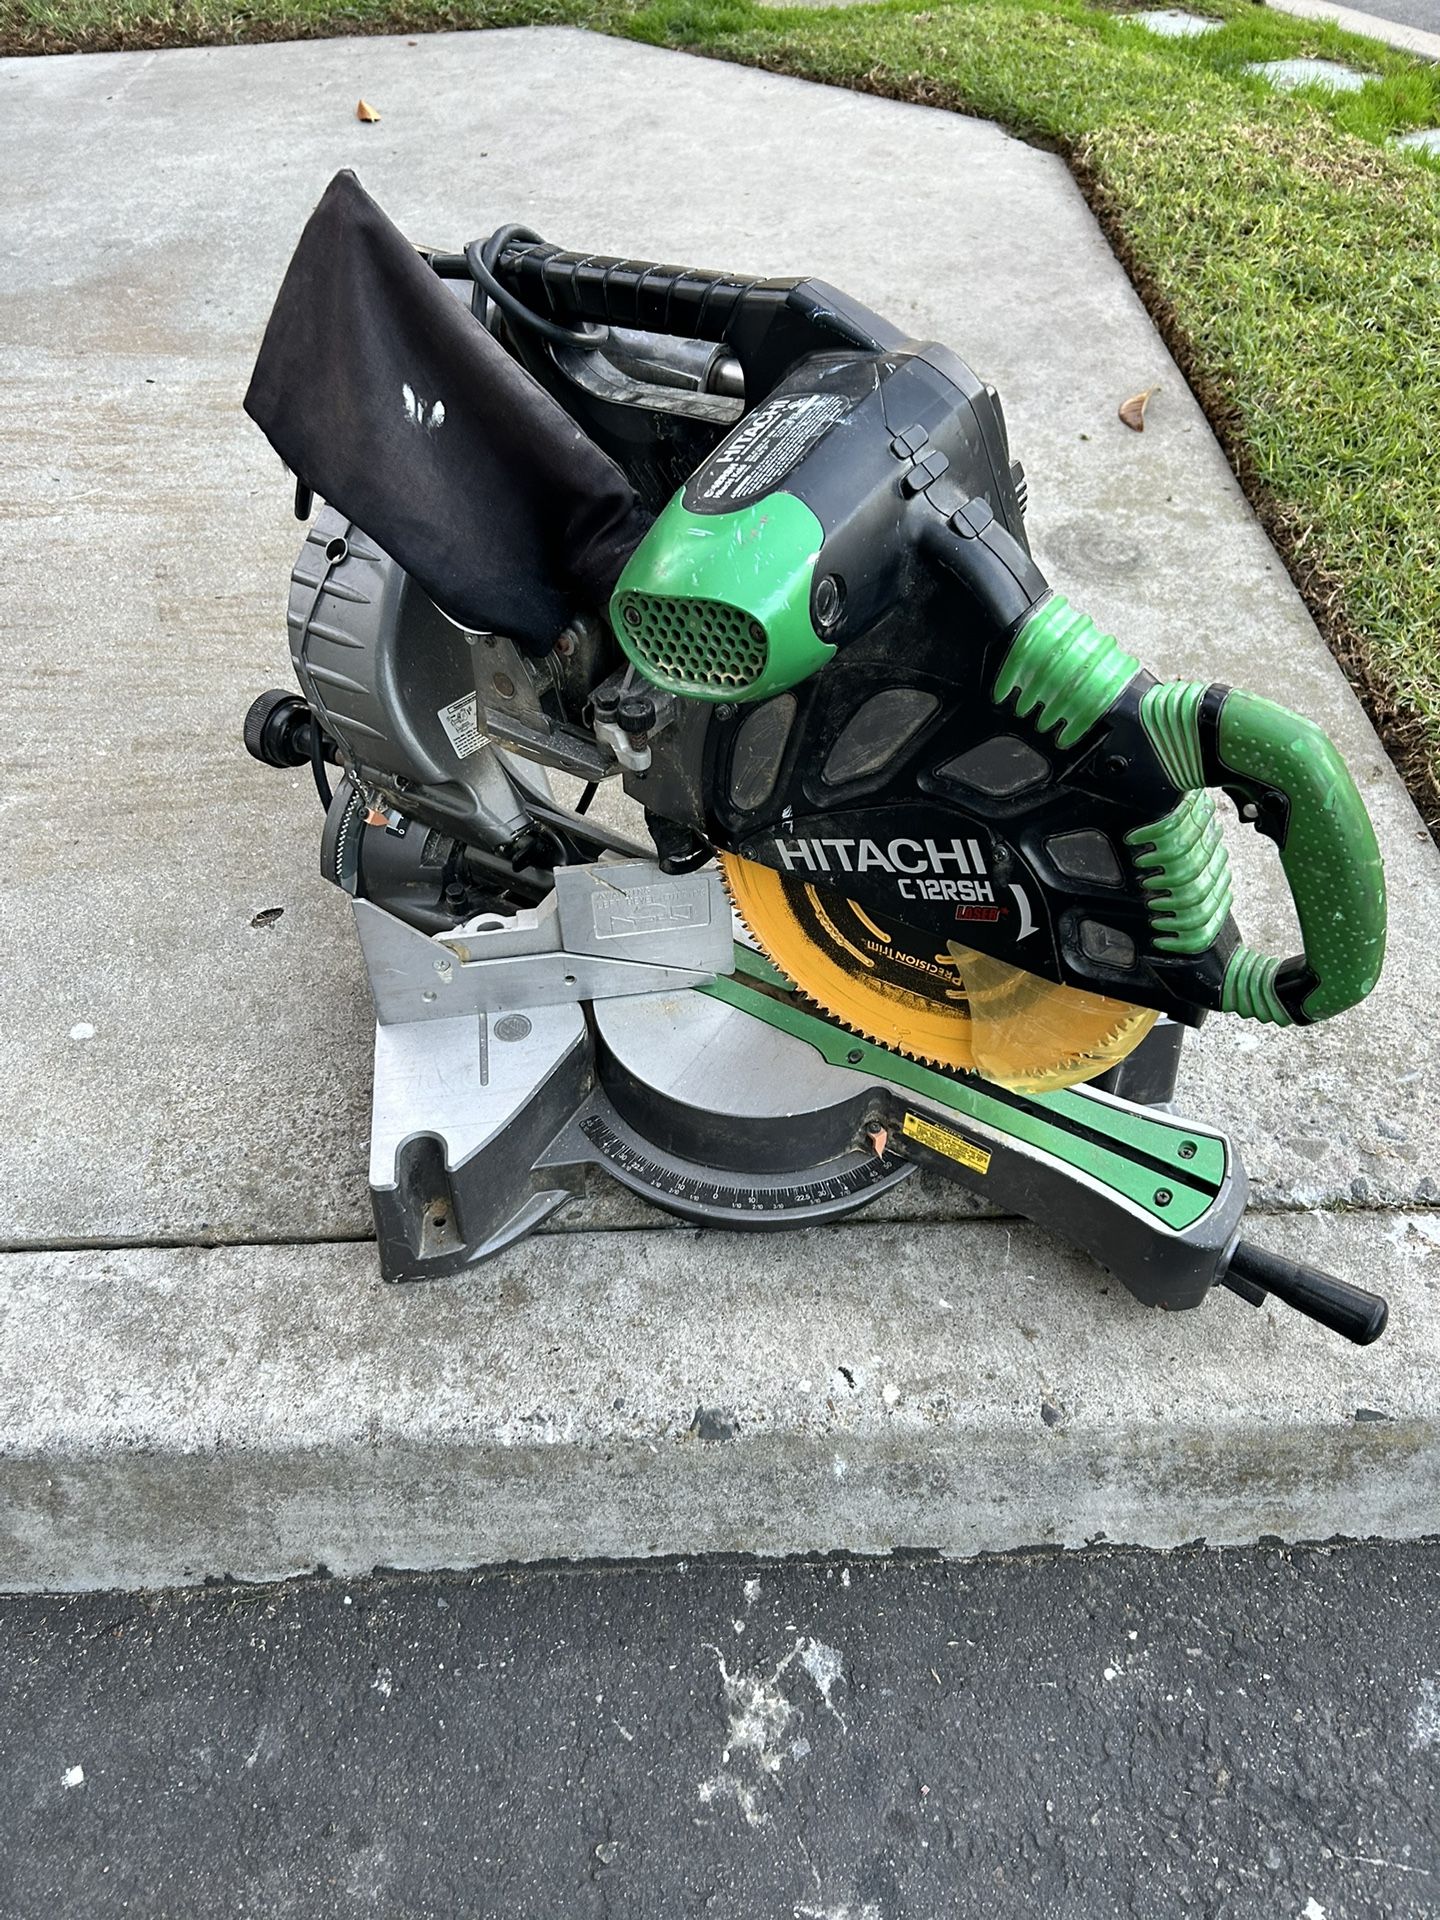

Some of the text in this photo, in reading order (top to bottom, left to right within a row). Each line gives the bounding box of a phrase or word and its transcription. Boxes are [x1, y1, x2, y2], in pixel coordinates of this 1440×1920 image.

[716, 399, 790, 463] HITACHI
[774, 838, 988, 875] HITACHI
[955, 905, 1001, 922] LASER
[677, 1183, 686, 1191] 10
[712, 1192, 719, 1200] 0
